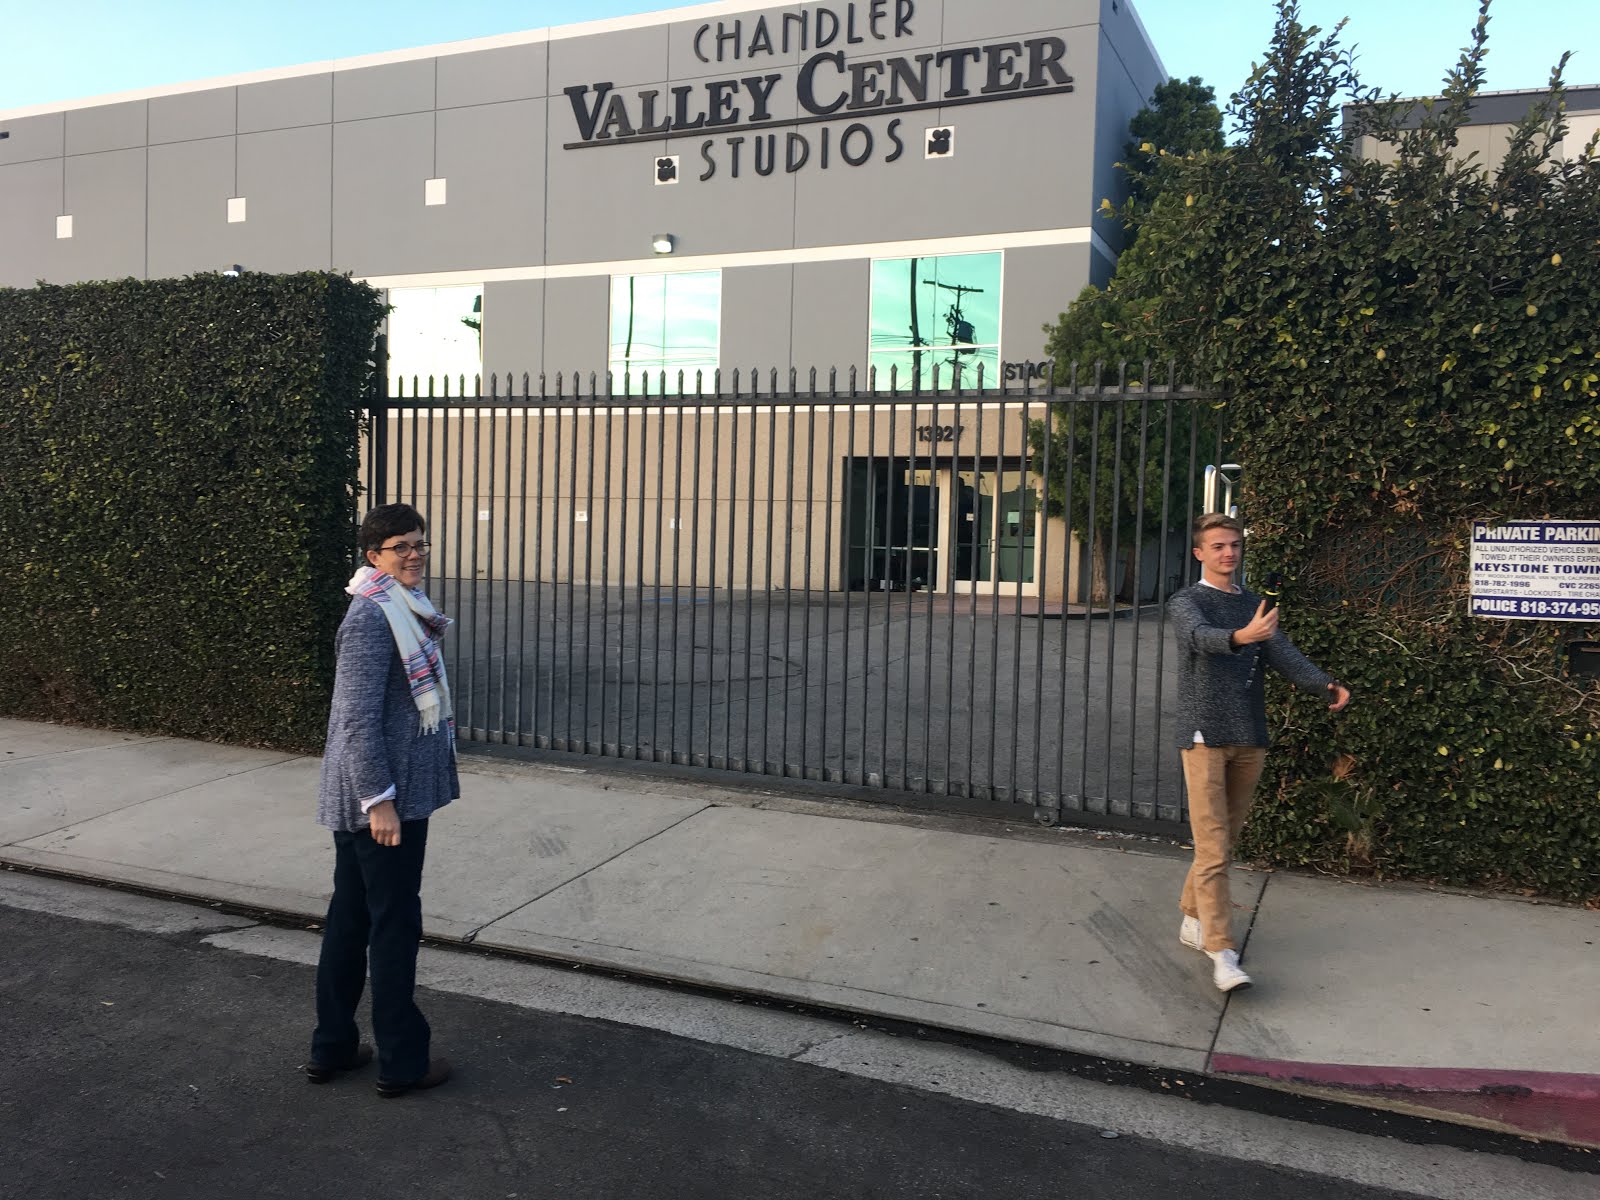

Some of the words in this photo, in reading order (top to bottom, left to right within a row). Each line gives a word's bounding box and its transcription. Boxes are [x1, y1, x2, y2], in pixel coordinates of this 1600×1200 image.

[694, 0, 914, 63] CHANDLER
[563, 73, 782, 141] VALLEY
[797, 37, 1073, 116] CENTER
[699, 118, 904, 182] STUDIOS
[915, 425, 965, 442] 13927
[1475, 526, 1541, 541] PRIVATE
[1481, 553, 1507, 561] TOWED
[1518, 554, 1541, 562] THEIR
[1490, 545, 1547, 553] UNAUTHORIZED
[1549, 546, 1586, 554] VEHICLES
[1474, 562, 1549, 574] KEYSTONE
[1473, 599, 1517, 612] POLICE
[1520, 601, 1600, 615] 818-374-95
